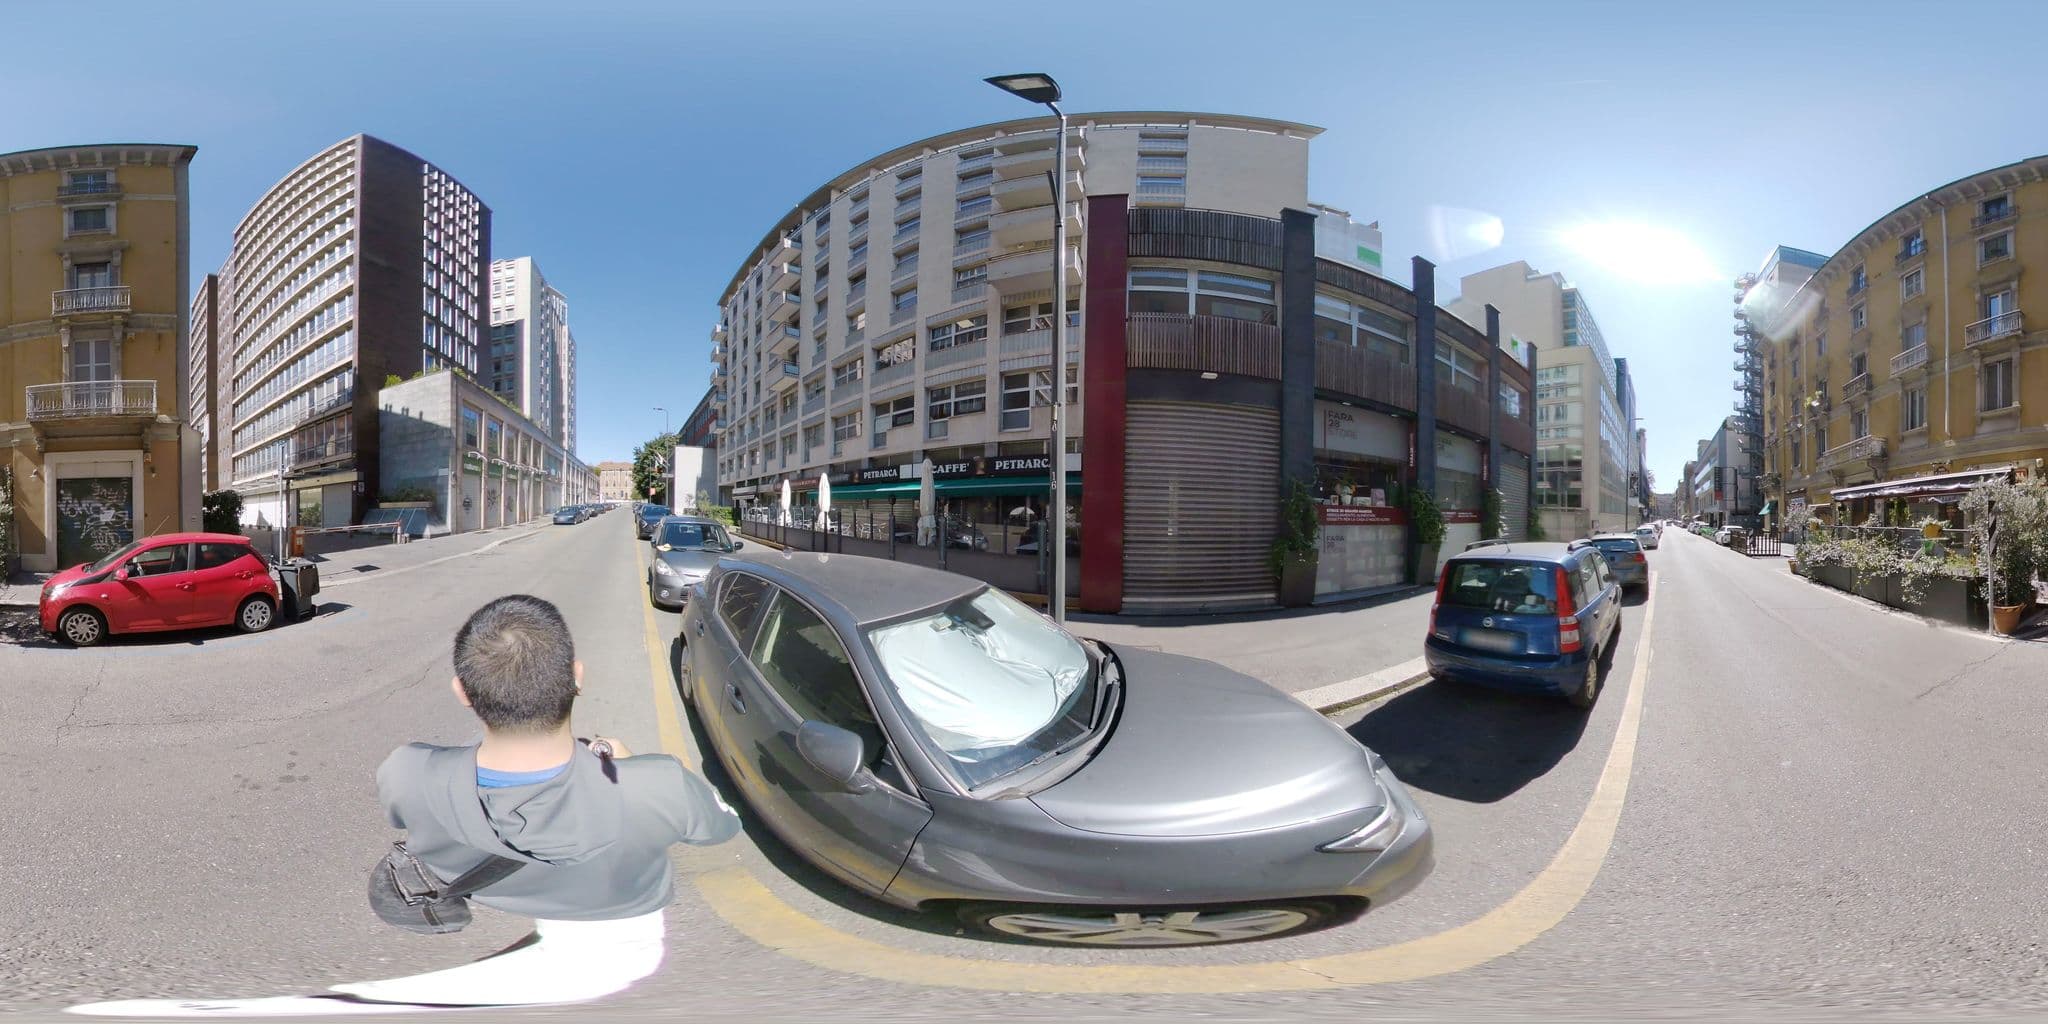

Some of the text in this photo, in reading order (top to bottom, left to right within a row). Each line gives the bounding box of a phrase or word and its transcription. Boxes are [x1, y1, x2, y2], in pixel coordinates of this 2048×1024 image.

[1328, 410, 1354, 423] FARA
[1328, 419, 1340, 428] 28
[931, 456, 1051, 474] CAFFE' PETRARC
[863, 468, 898, 479] PETRARCA
